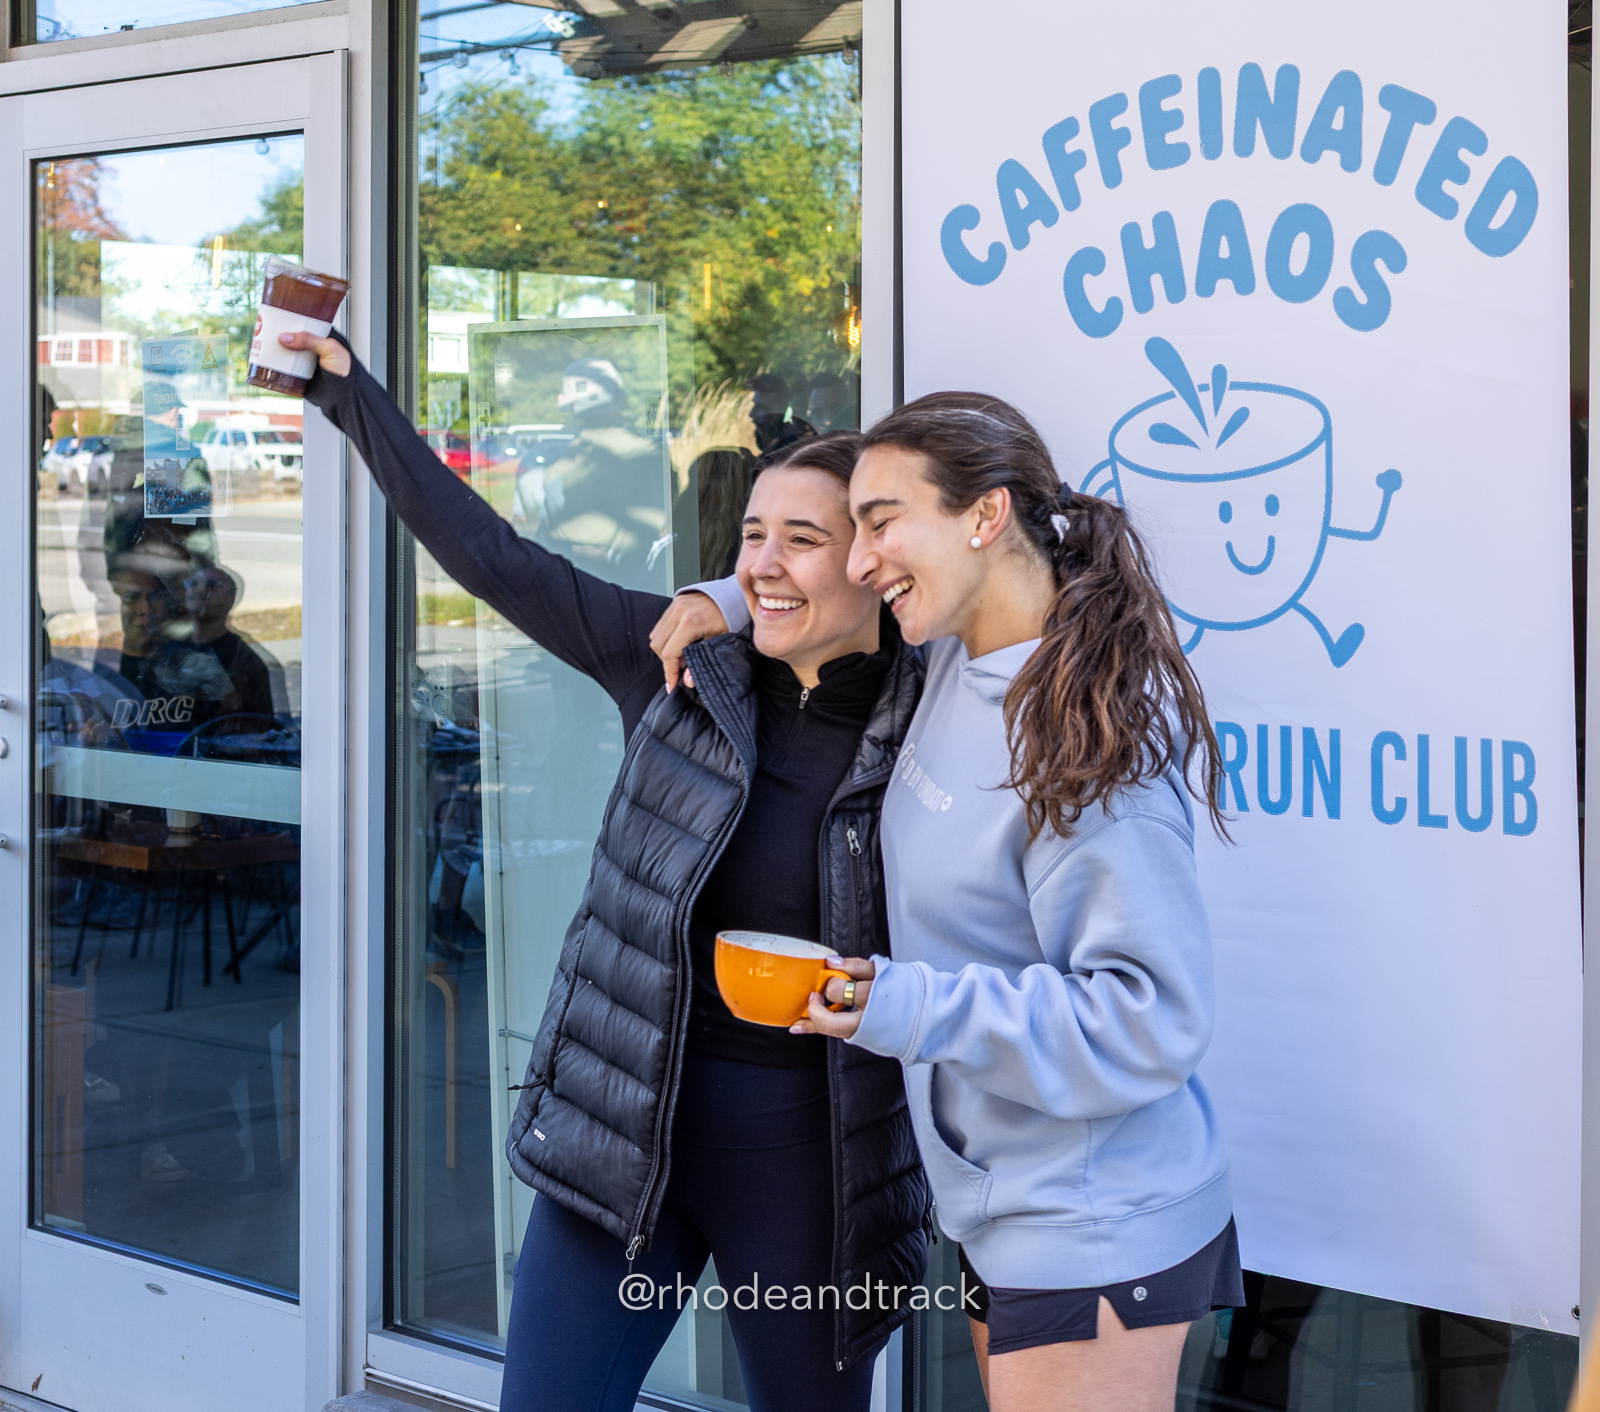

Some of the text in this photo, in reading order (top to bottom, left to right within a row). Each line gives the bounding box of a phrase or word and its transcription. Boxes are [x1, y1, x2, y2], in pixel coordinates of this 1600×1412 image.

[940, 62, 1539, 287] CAFFEINATED
[1063, 198, 1408, 338] CHAOS
[111, 695, 195, 728] DRC
[1215, 720, 1538, 837] RUN CLUB
